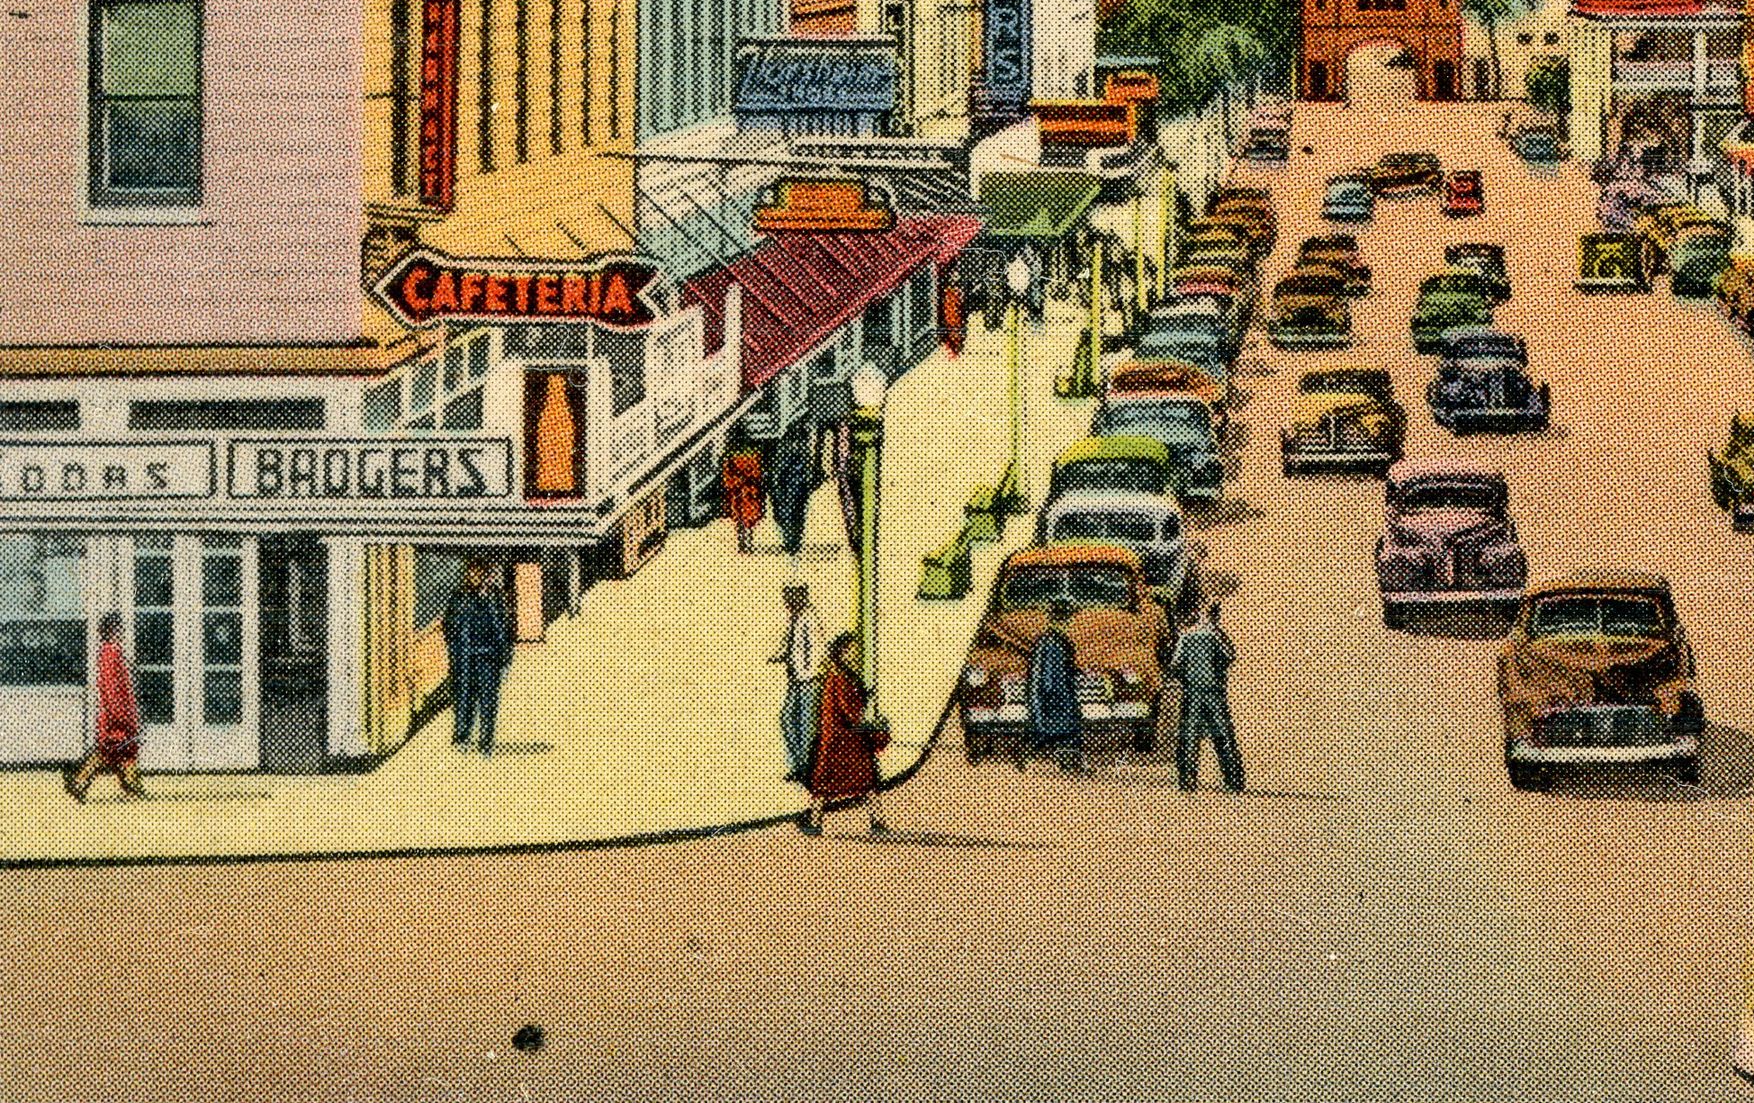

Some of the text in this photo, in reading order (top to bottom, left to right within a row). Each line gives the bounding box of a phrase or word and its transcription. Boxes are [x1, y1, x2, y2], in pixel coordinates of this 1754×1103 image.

[401, 265, 634, 314] CAFETERIA
[0, 458, 169, 493] ODAS
[255, 448, 487, 498] BADGERS
